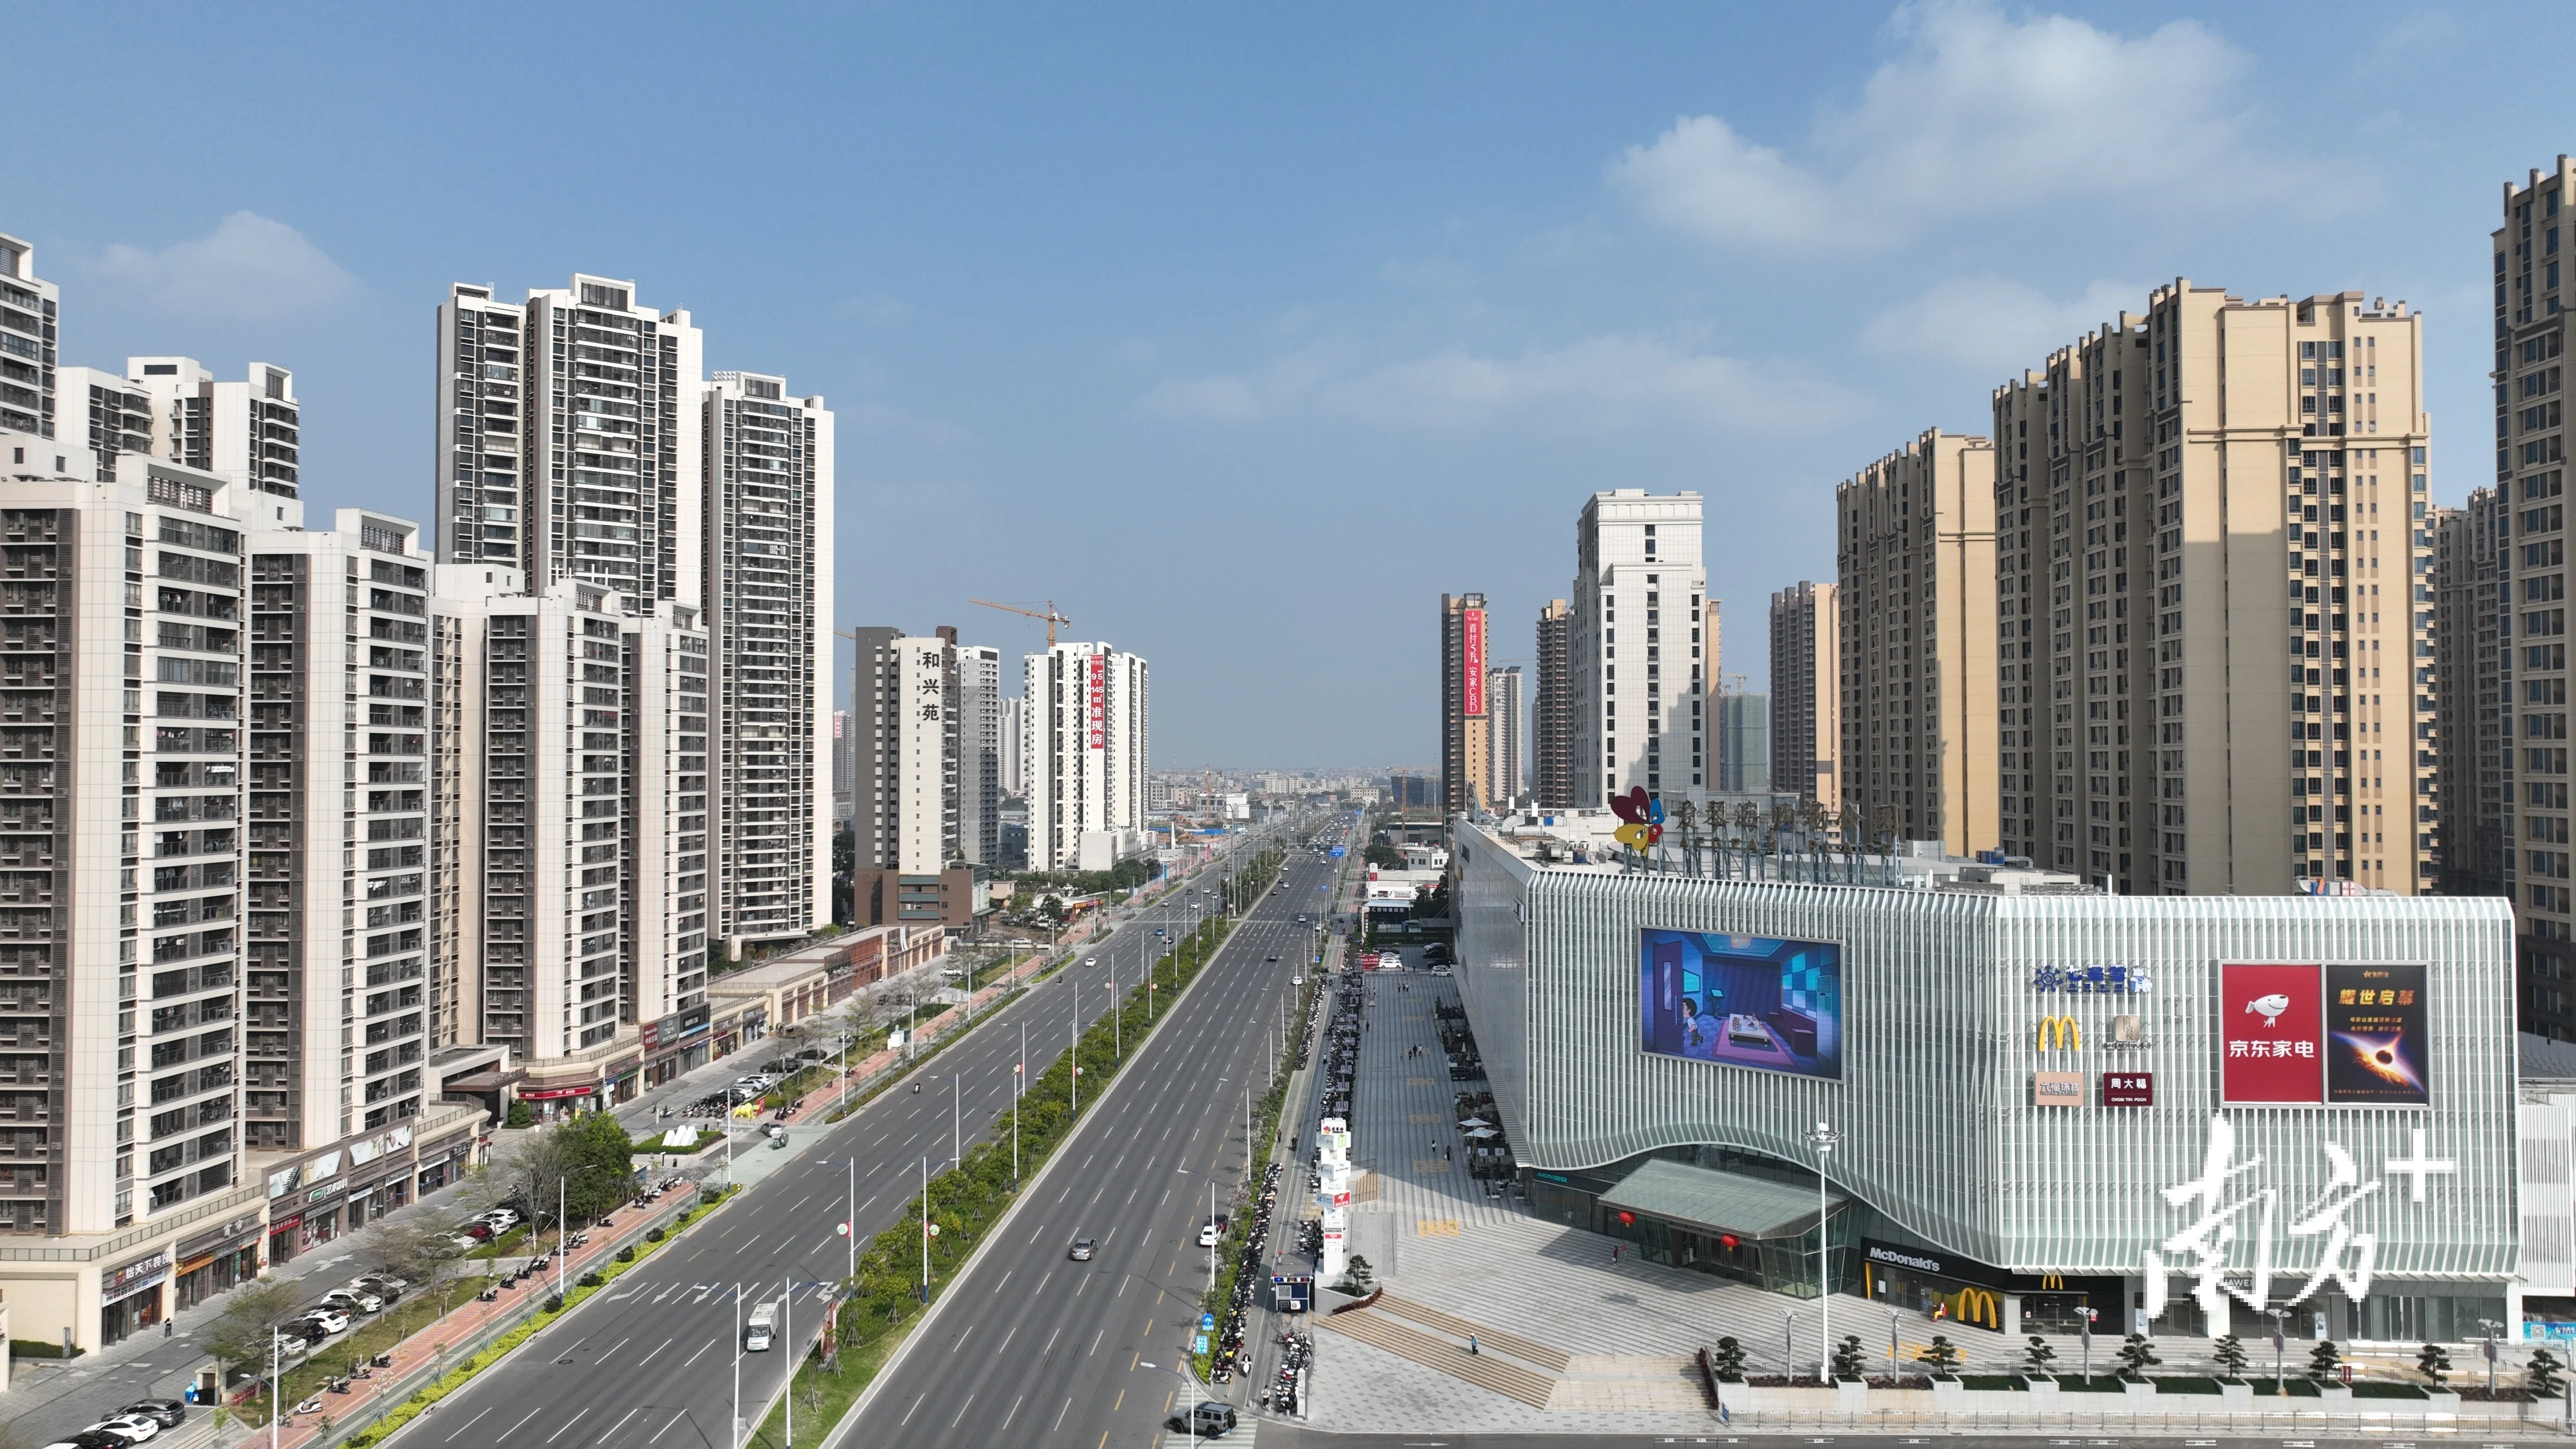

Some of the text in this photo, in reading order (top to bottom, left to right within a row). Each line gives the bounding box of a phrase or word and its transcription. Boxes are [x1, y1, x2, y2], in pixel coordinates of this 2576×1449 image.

[923, 652, 940, 721] 和兴苑
[1679, 837, 1892, 857] AEGEAN PLACE
[2339, 988, 2415, 1006] 耀世启幕
[2229, 1040, 2314, 1058] 京东家电
[2111, 1078, 2147, 1089] 周大福
[125, 1251, 170, 1280] 怡天下装饰
[1870, 1247, 1940, 1272] McDonald's
